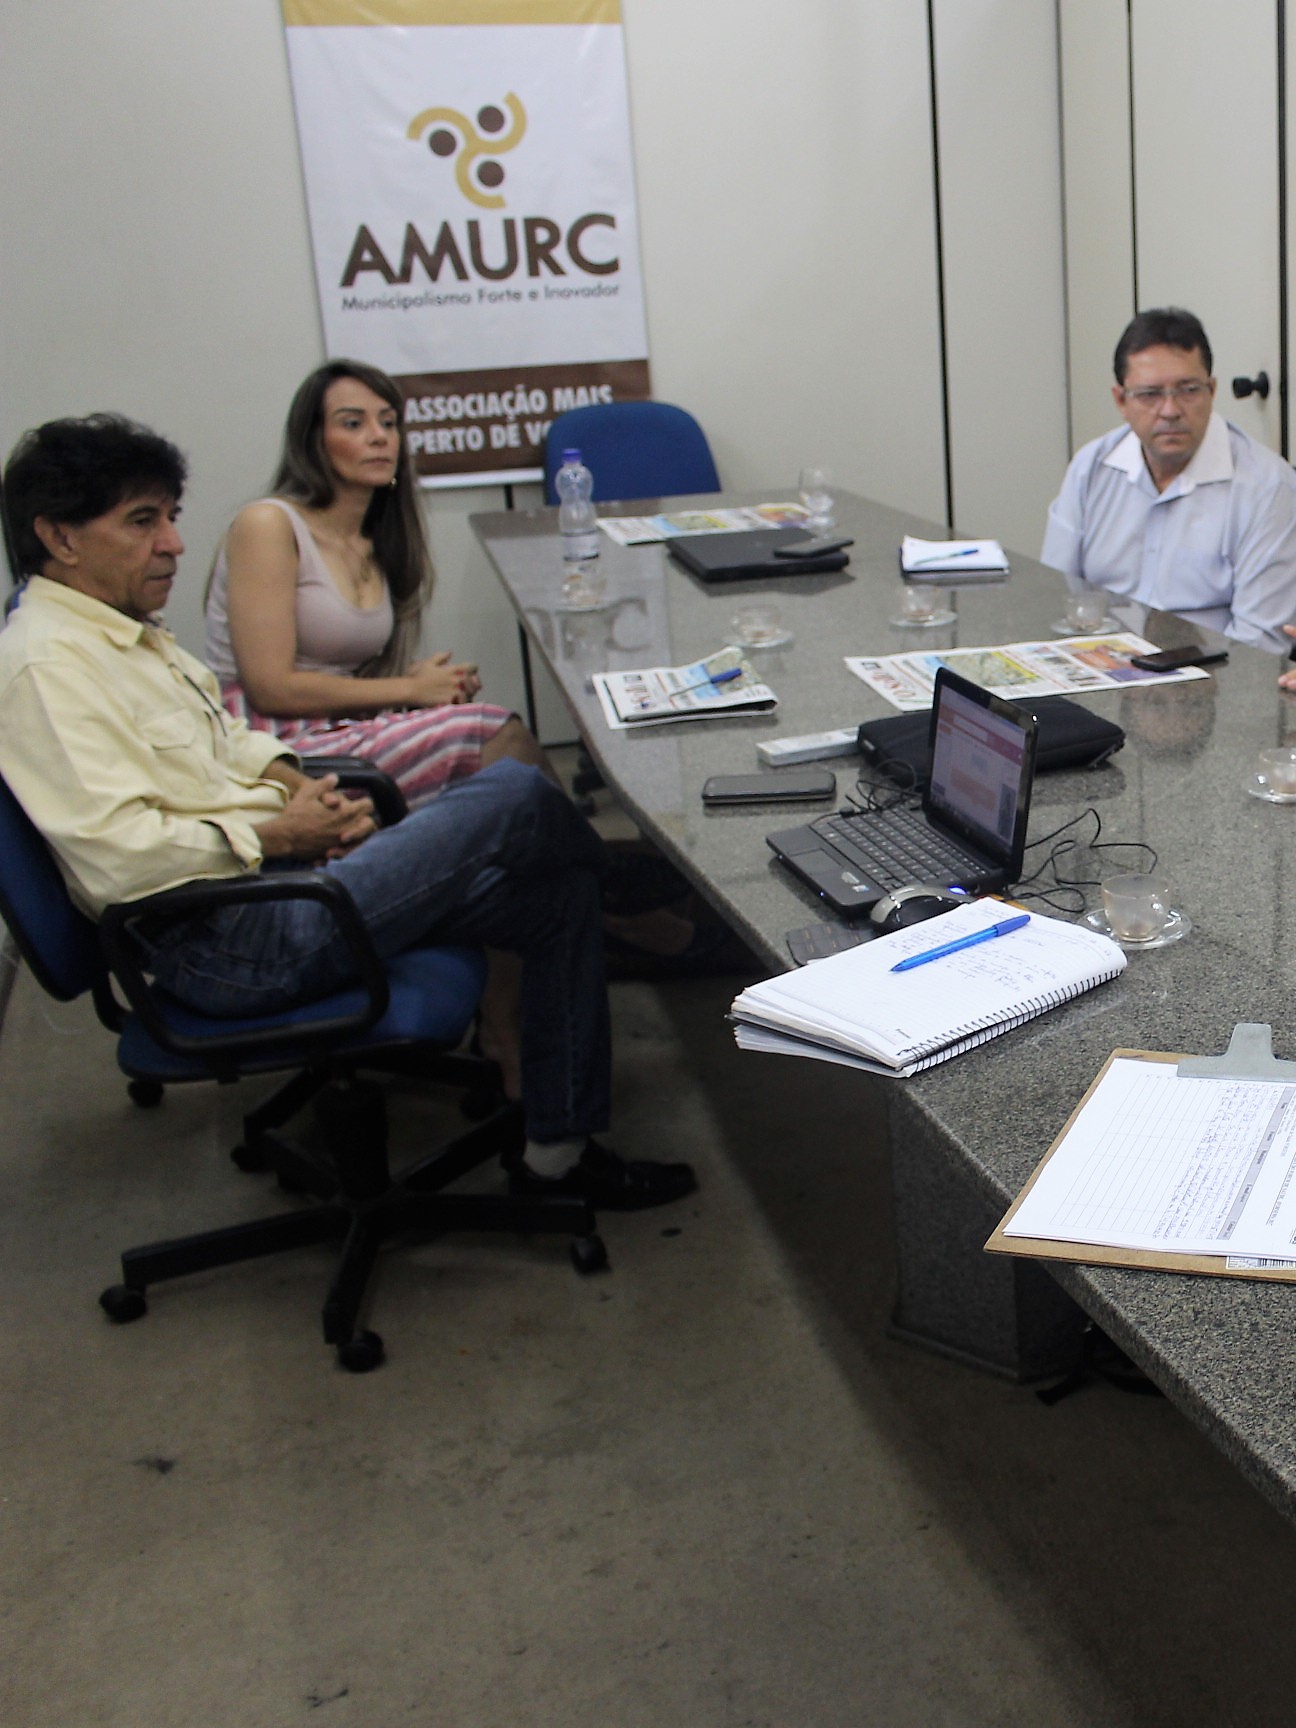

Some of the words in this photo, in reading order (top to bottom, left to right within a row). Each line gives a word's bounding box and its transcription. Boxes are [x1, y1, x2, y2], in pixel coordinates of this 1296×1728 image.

[339, 213, 620, 288] AMURC
[341, 289, 471, 311] Municipalismo
[477, 288, 522, 304] Forte
[528, 290, 540, 300] e
[544, 281, 620, 298] Inovador
[404, 384, 548, 423] ASSOCIAÇÃO
[552, 384, 613, 412] MAIS
[406, 425, 485, 455] PERTO
[489, 423, 521, 449] DE
